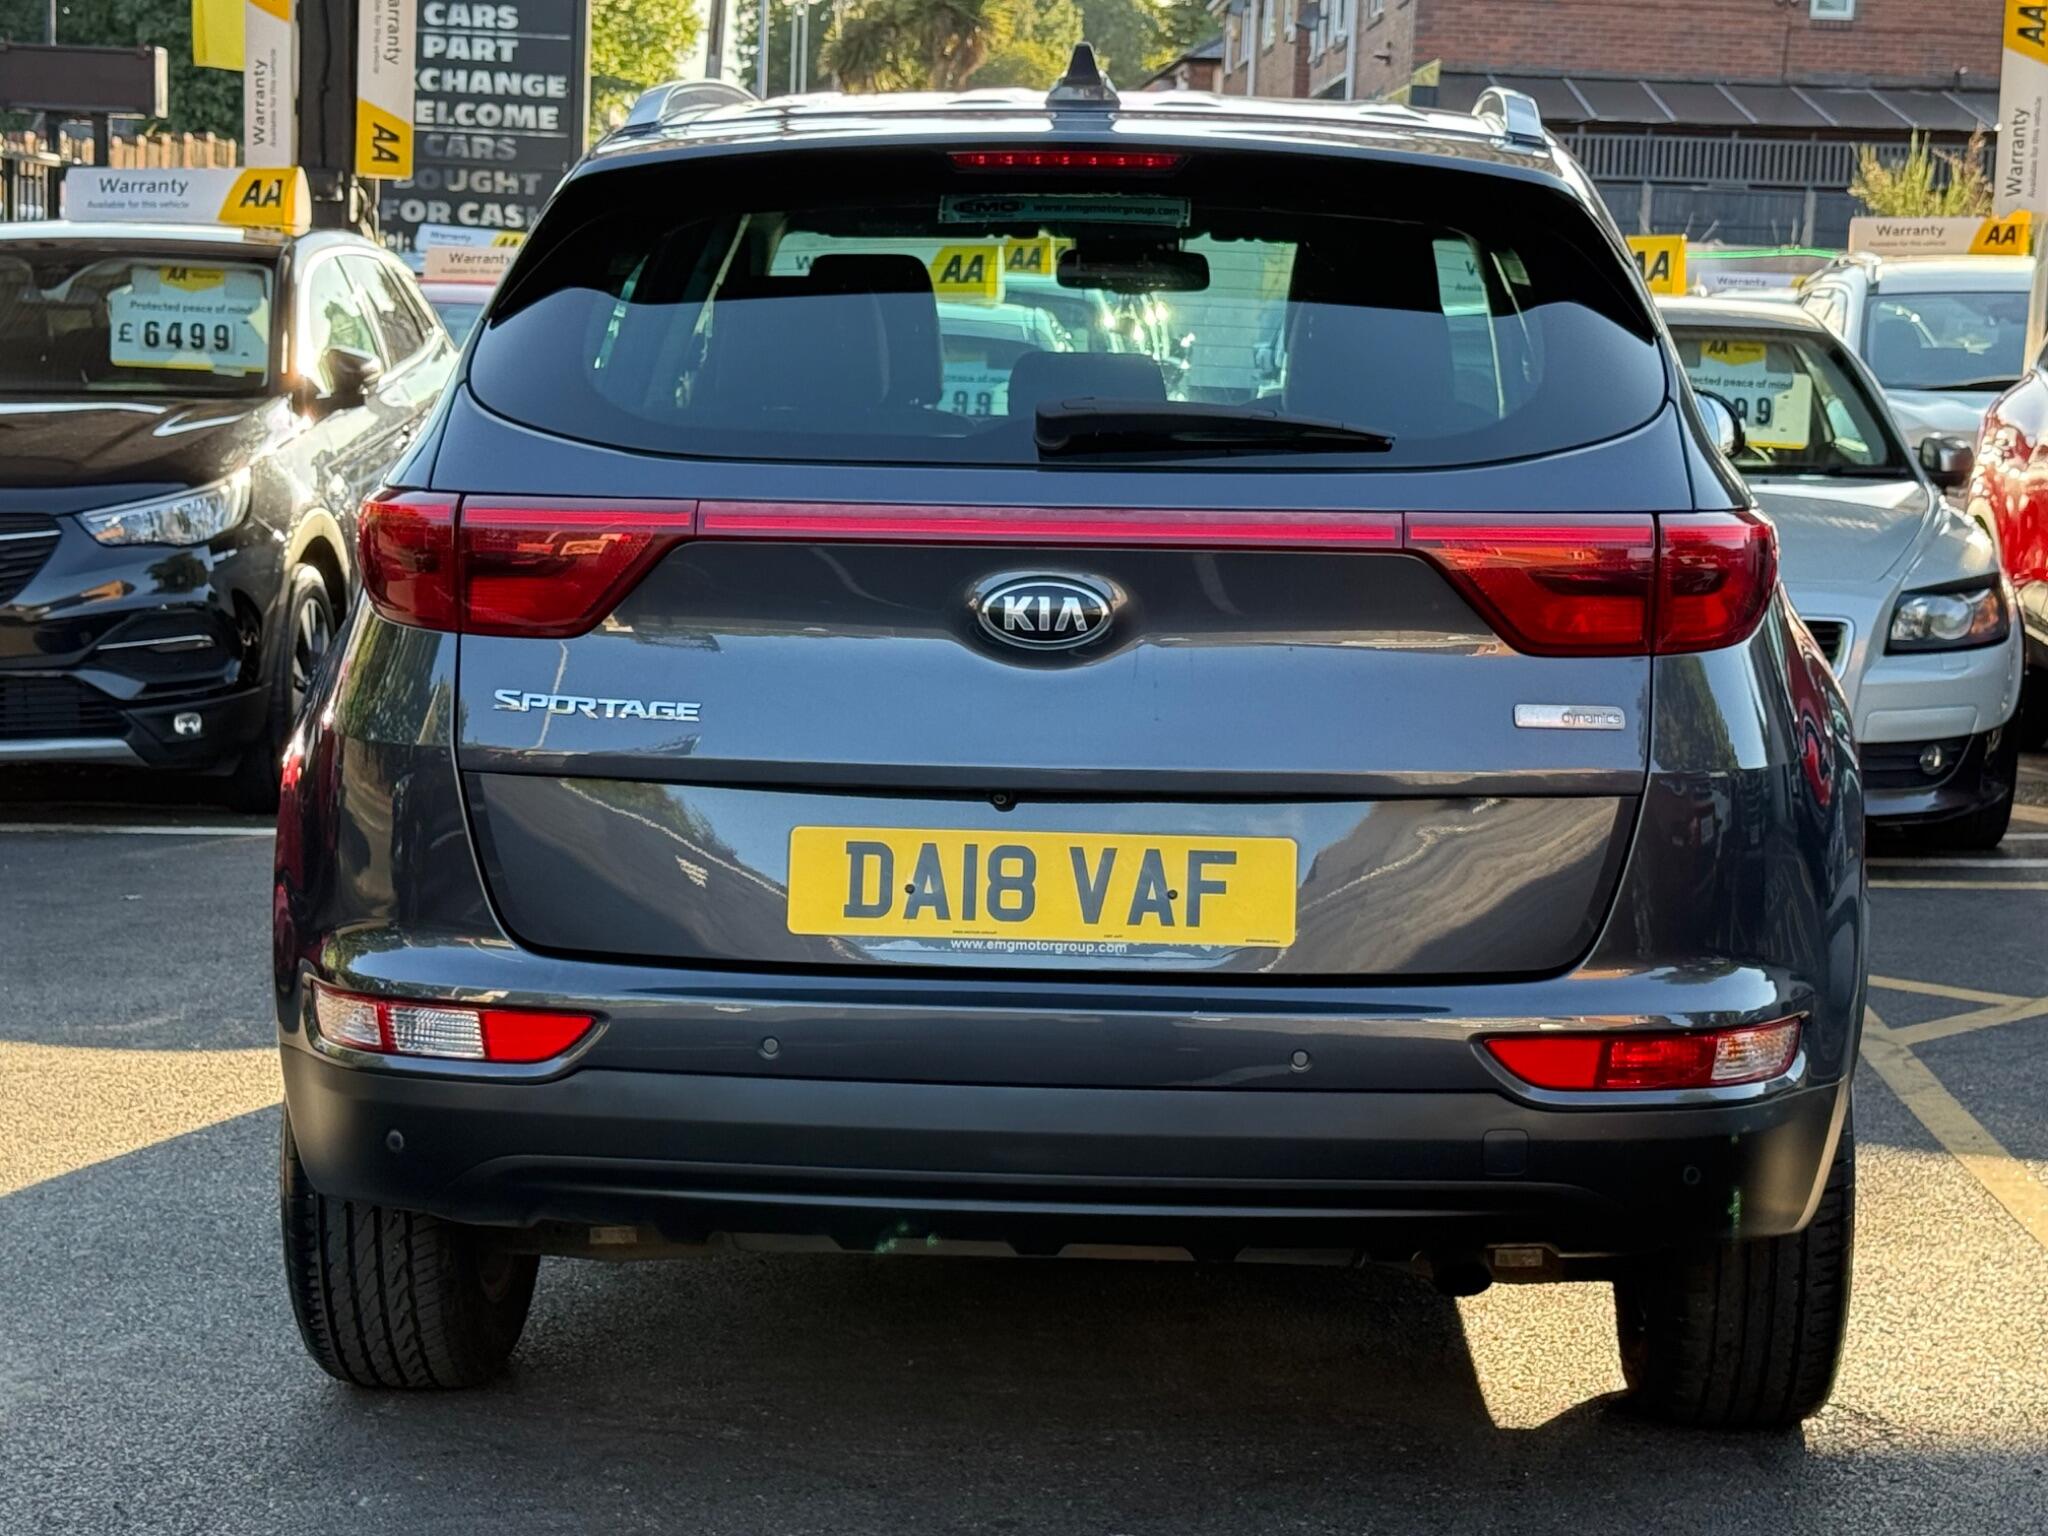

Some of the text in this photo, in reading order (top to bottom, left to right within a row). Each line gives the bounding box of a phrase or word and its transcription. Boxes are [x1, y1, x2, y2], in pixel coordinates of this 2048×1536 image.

[423, 2, 519, 30] CARS
[2017, 6, 2047, 47] AA
[383, 0, 402, 65] arranty
[422, 34, 519, 62] PART
[414, 67, 567, 98] CHANGE
[253, 59, 268, 146] Warranty
[414, 99, 560, 130] ELCOME
[371, 122, 400, 163] AA
[423, 133, 518, 161] CARS
[2005, 108, 2030, 198] Warranty
[99, 177, 189, 196] Warranty
[239, 179, 283, 208] AA
[393, 168, 542, 195] OUGHT
[380, 198, 452, 224] FOR
[1876, 225, 1944, 239] Warranty
[1984, 225, 2017, 246] AA
[940, 254, 985, 284] AA
[1008, 247, 1041, 270] AA
[168, 267, 187, 281] AA
[130, 300, 252, 315] Protected peace of mind
[118, 320, 230, 351] £ 6499
[1708, 340, 1728, 354] AA
[1723, 378, 1754, 389] peace
[1756, 380, 1766, 388] of
[1768, 380, 1793, 390] mind
[1003, 596, 1088, 632] KIA
[493, 689, 702, 722] SPORTAGE
[843, 841, 1237, 928] DA18 VAF
[950, 938, 1128, 955] www.emgmotorgroup.com
